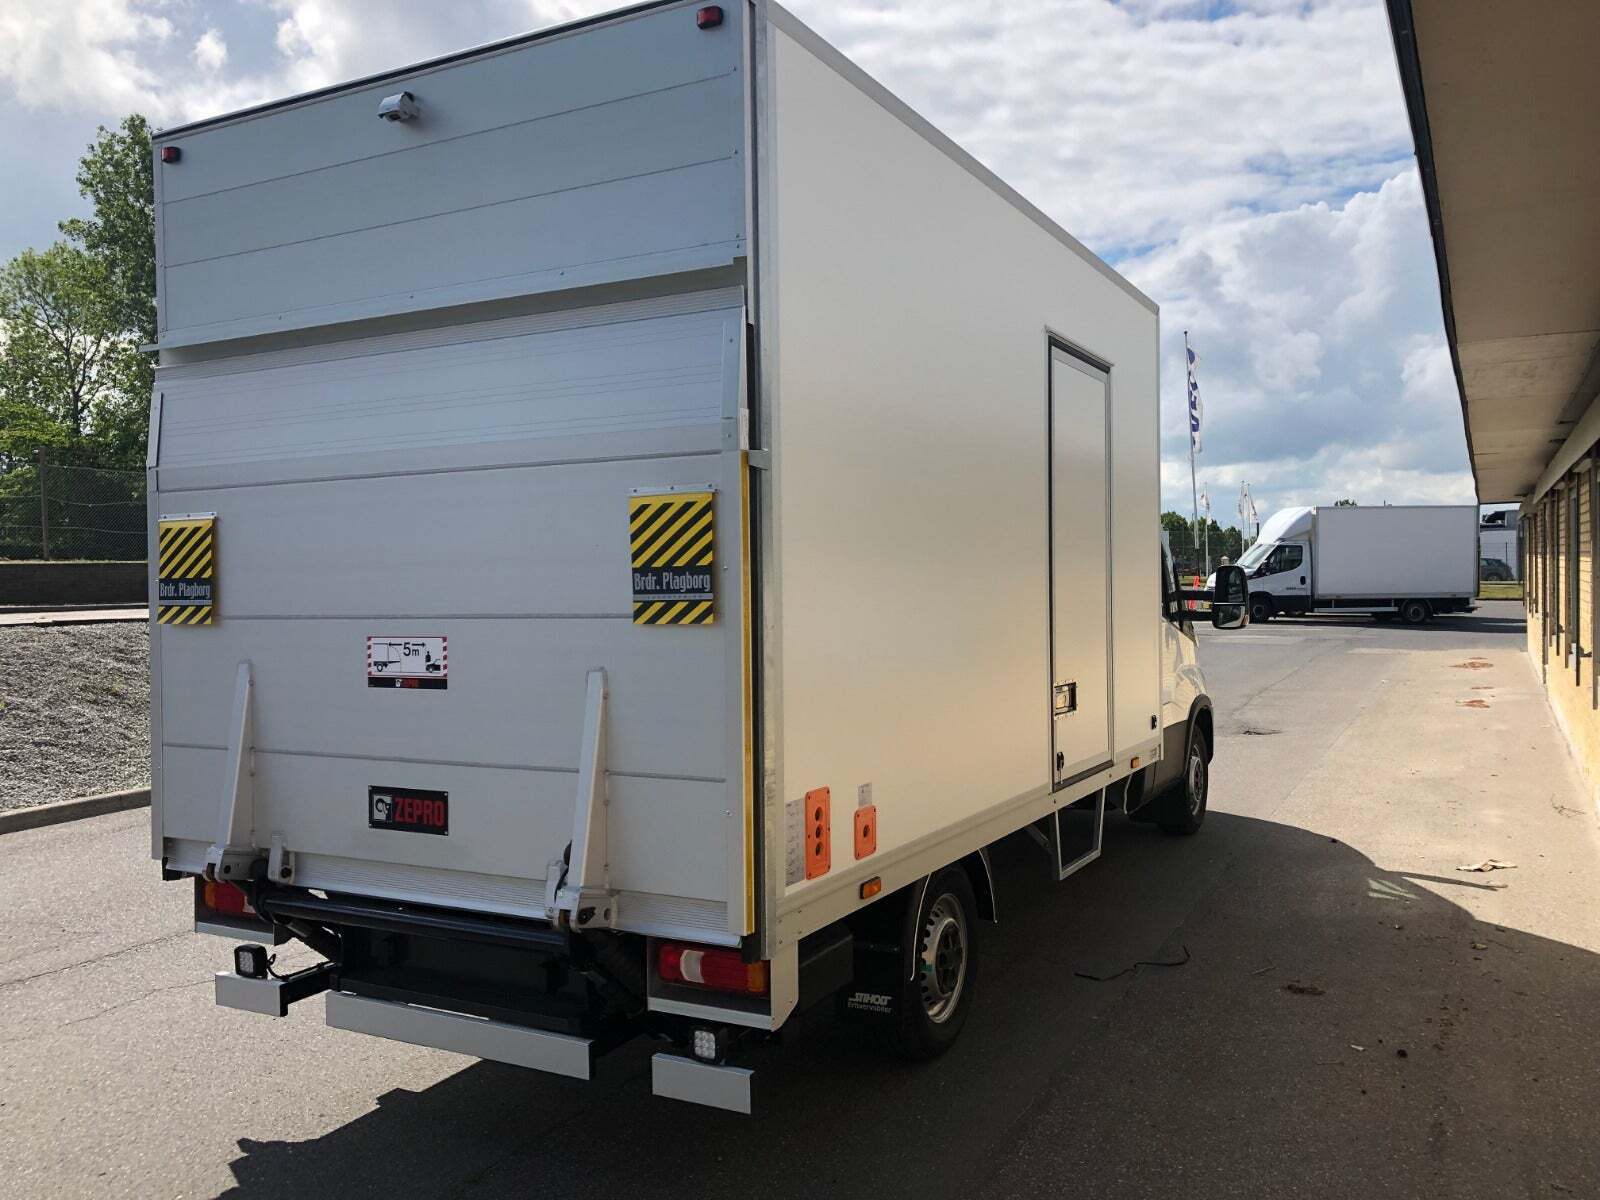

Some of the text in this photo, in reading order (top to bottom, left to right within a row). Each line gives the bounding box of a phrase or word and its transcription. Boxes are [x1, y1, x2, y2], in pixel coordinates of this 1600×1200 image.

[160, 582, 211, 599] Brdr. Plagborg
[633, 571, 711, 593] Brdr. Plagborg
[394, 797, 445, 827] ZEPRO
